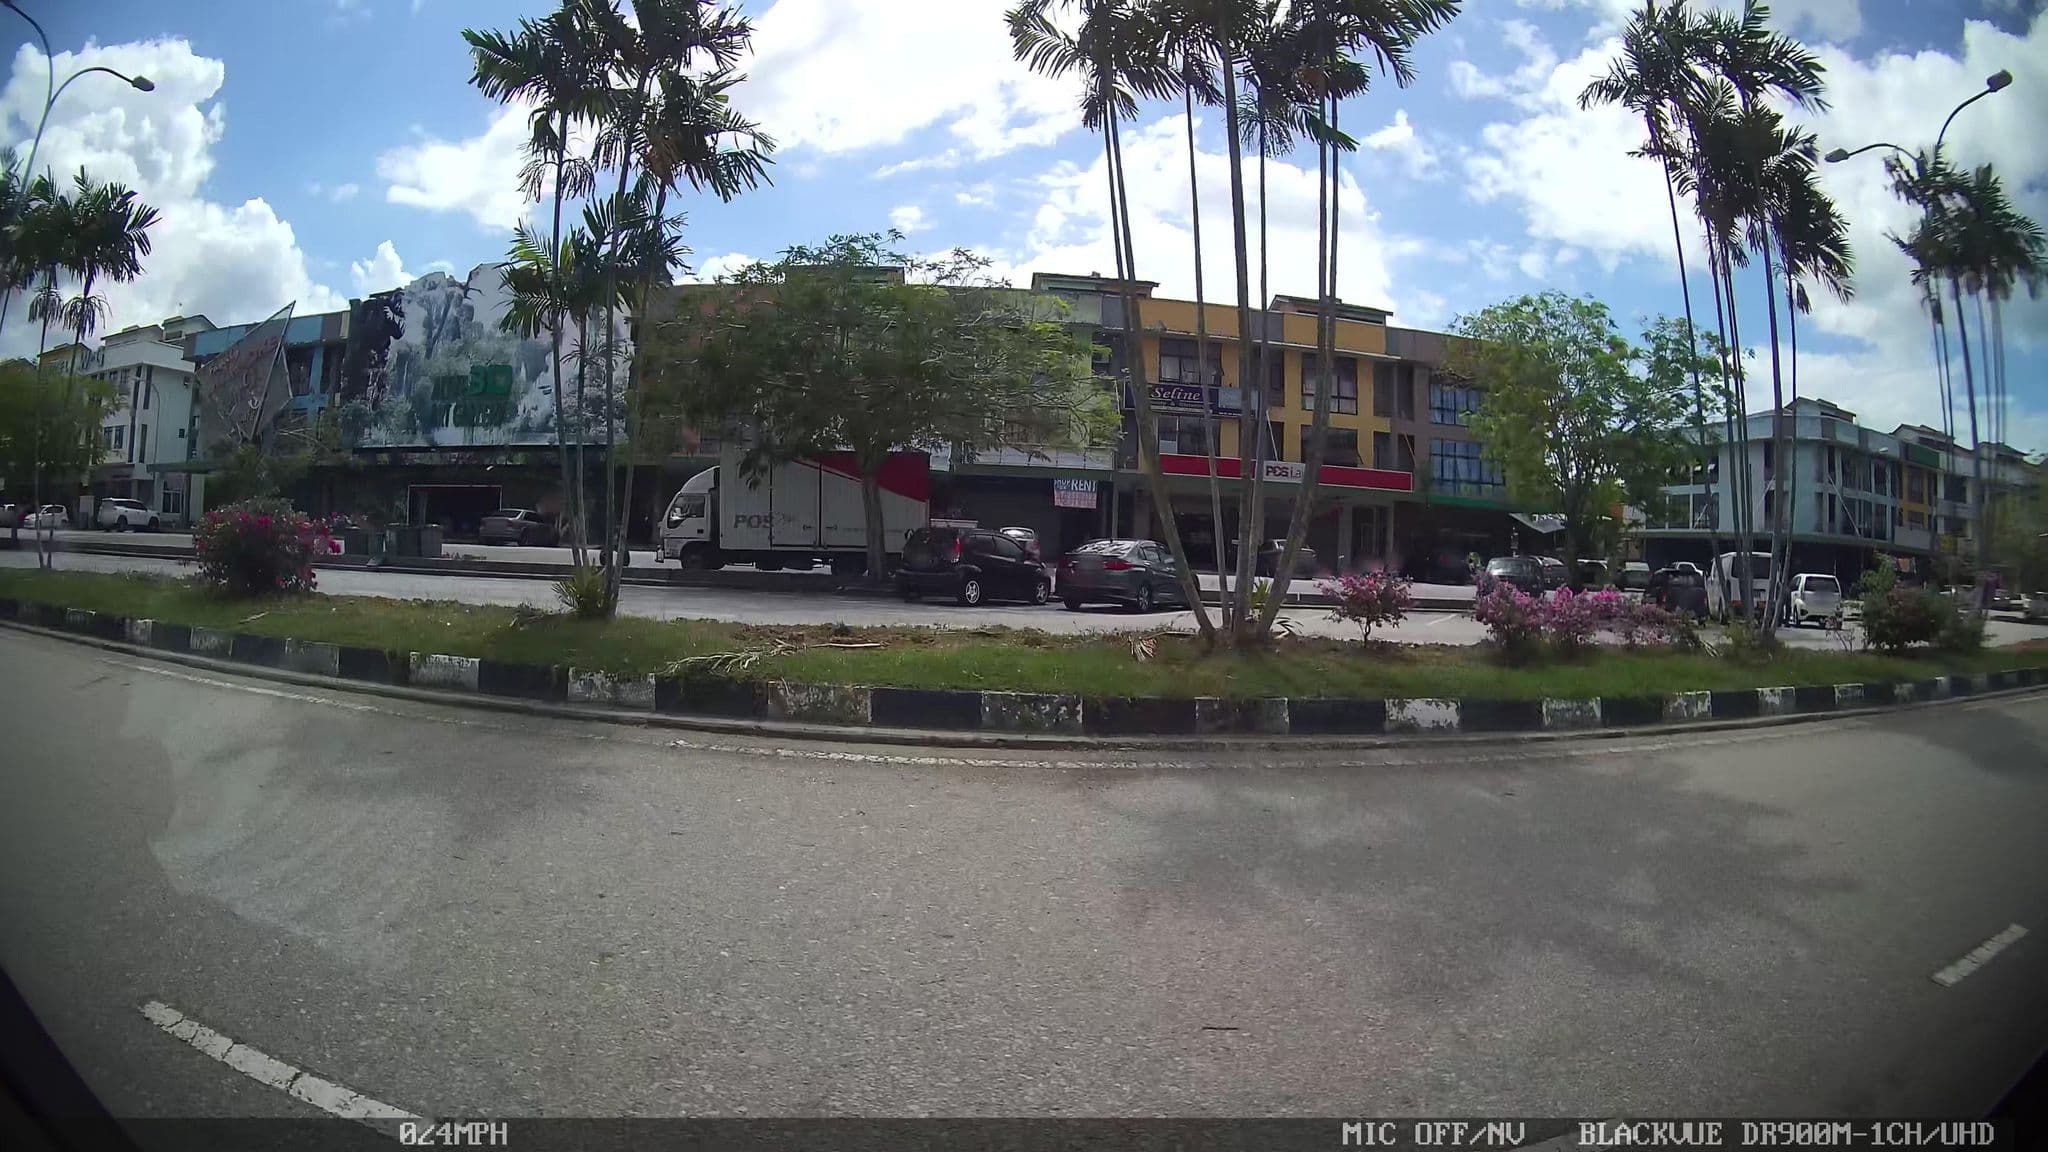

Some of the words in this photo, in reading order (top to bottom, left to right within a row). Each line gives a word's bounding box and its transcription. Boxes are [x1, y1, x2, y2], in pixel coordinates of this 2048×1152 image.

[1150, 387, 1201, 401] Seline
[1266, 465, 1289, 477] POS
[1071, 479, 1097, 492] RENT
